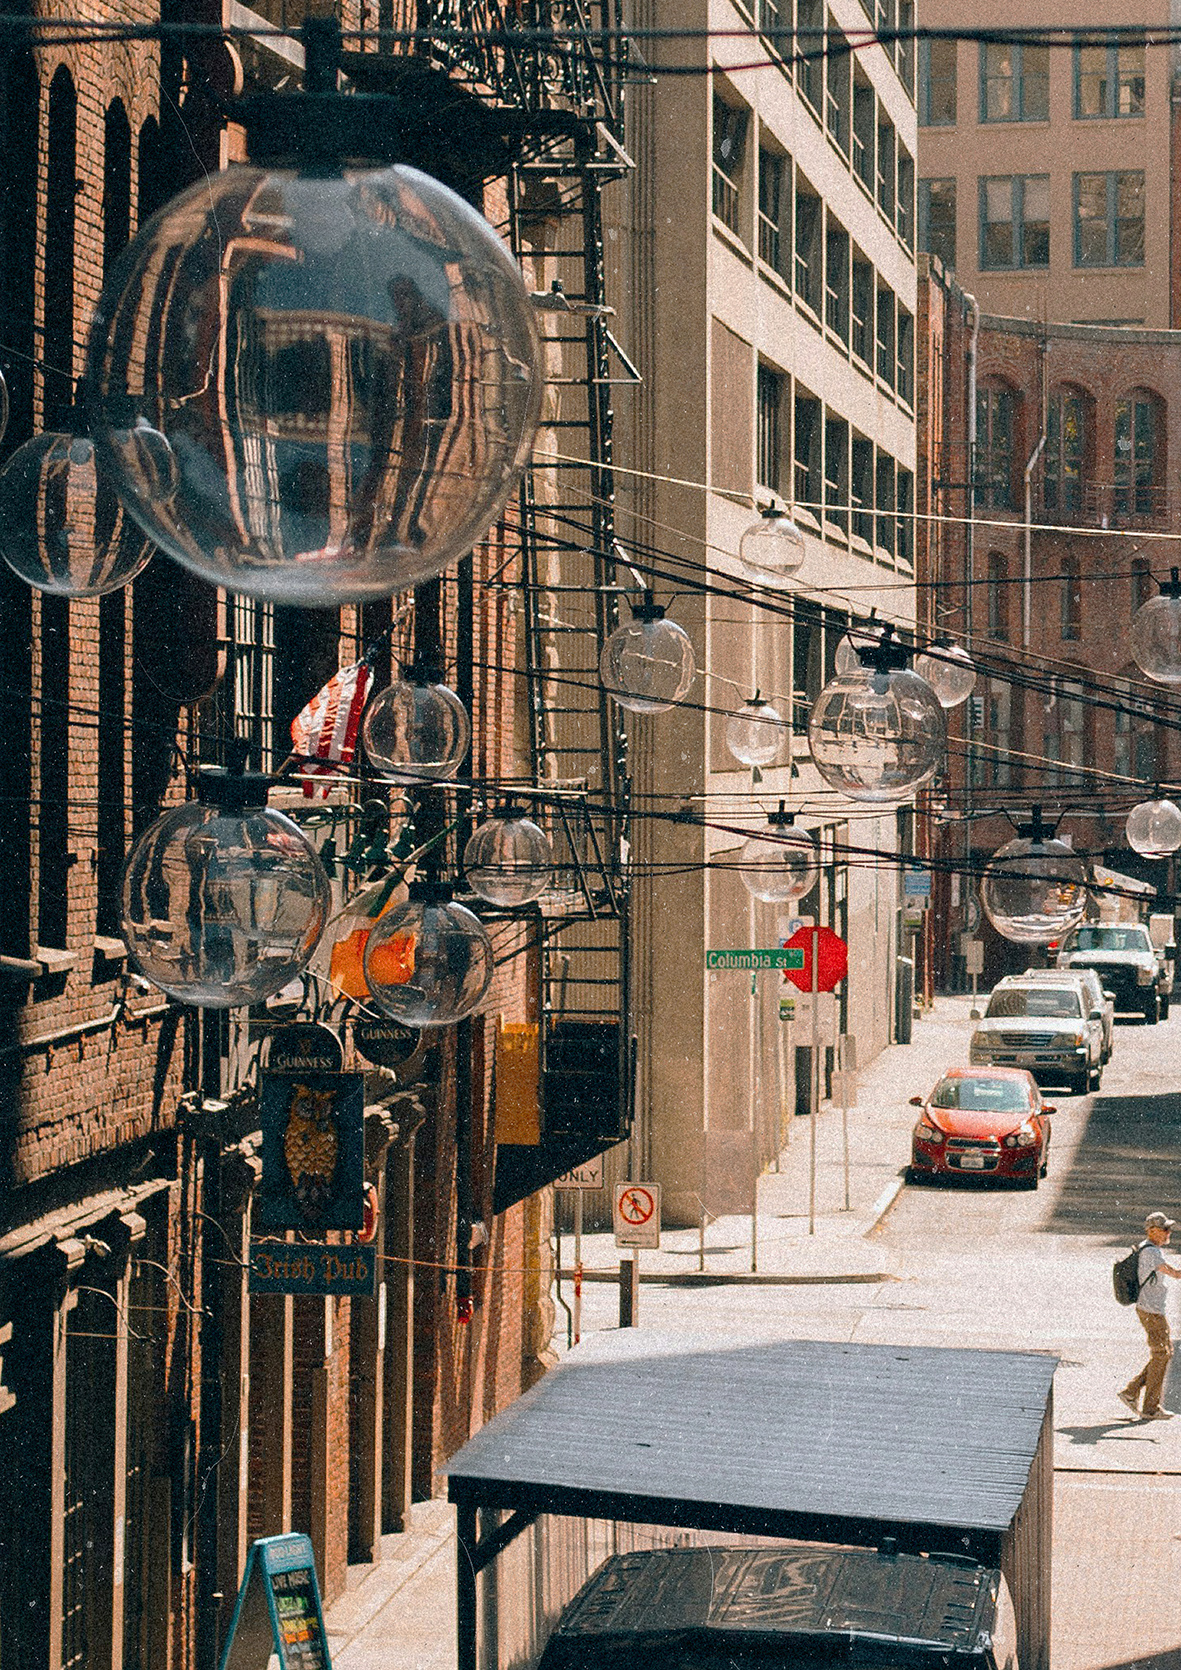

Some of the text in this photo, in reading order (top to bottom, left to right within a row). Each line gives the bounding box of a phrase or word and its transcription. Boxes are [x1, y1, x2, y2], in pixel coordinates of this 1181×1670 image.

[708, 952, 772, 968] Columbia
[361, 1028, 412, 1040] GUINNESS
[277, 1054, 333, 1068] GUINNESS
[255, 1253, 369, 1285] Irish Pub
